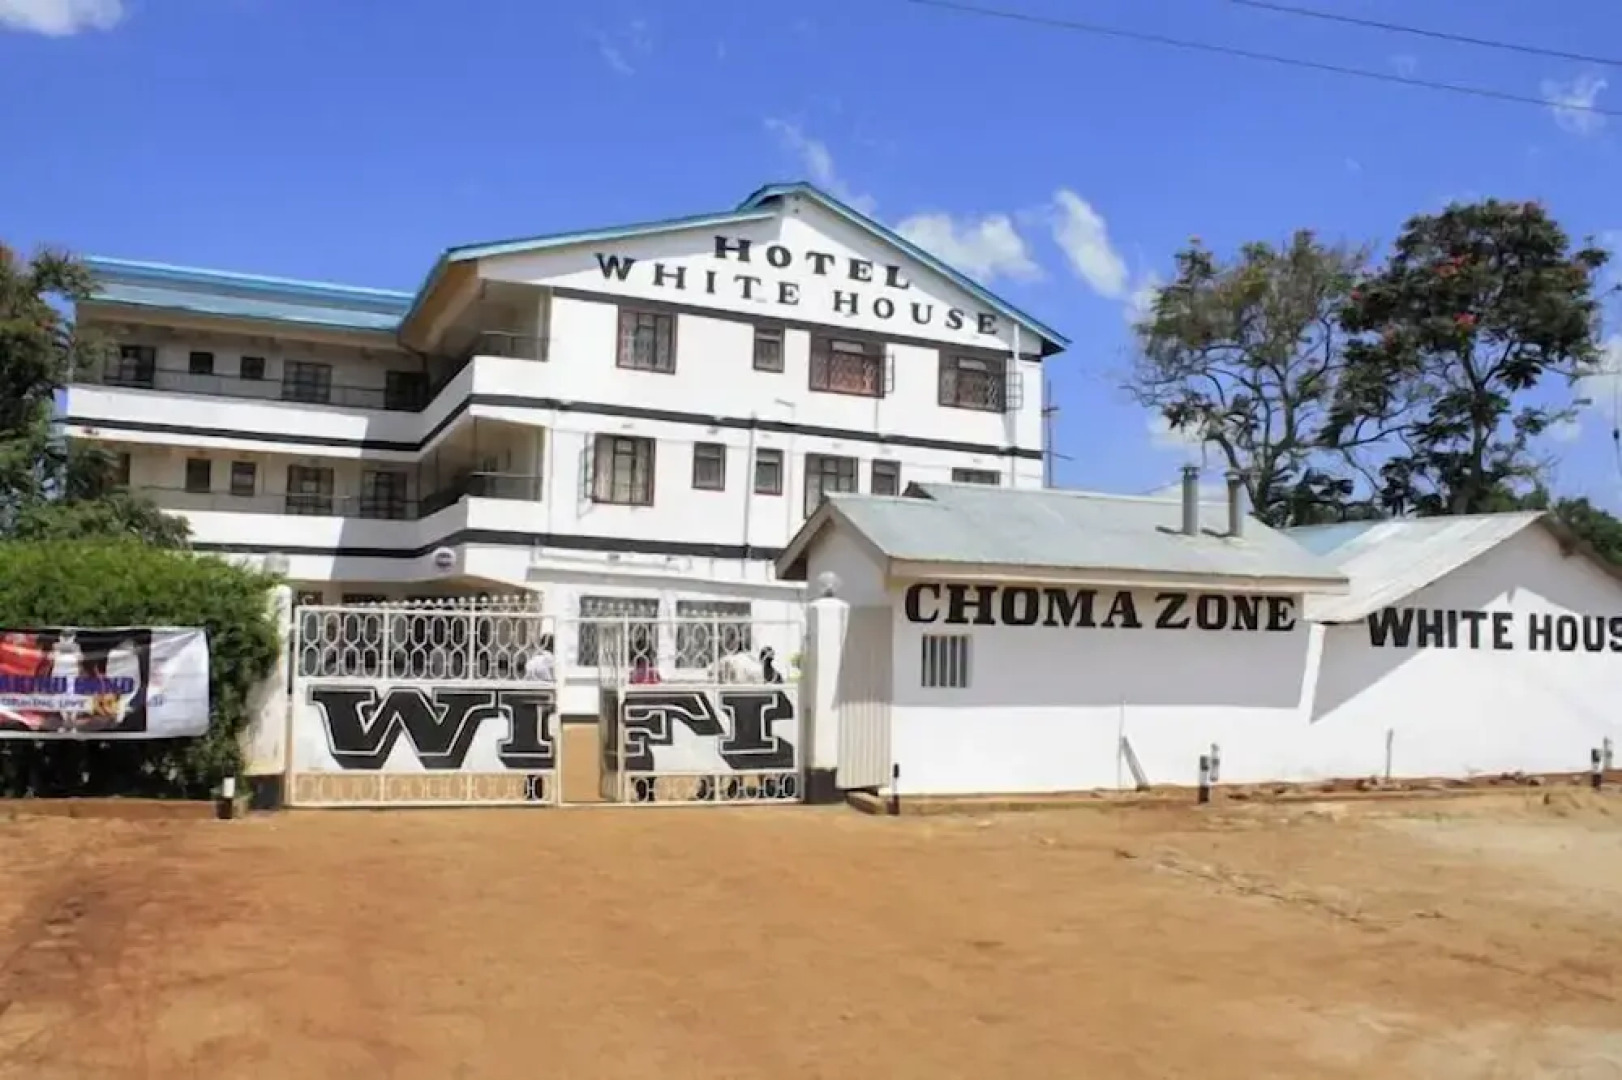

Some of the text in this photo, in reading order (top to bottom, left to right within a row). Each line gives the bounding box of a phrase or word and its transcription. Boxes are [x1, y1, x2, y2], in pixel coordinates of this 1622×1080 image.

[714, 235, 910, 290] HOTEL
[595, 252, 999, 335] WHITE HOUSE
[904, 583, 1297, 632] CHOMA ZONE
[1367, 606, 1514, 649] WHITE
